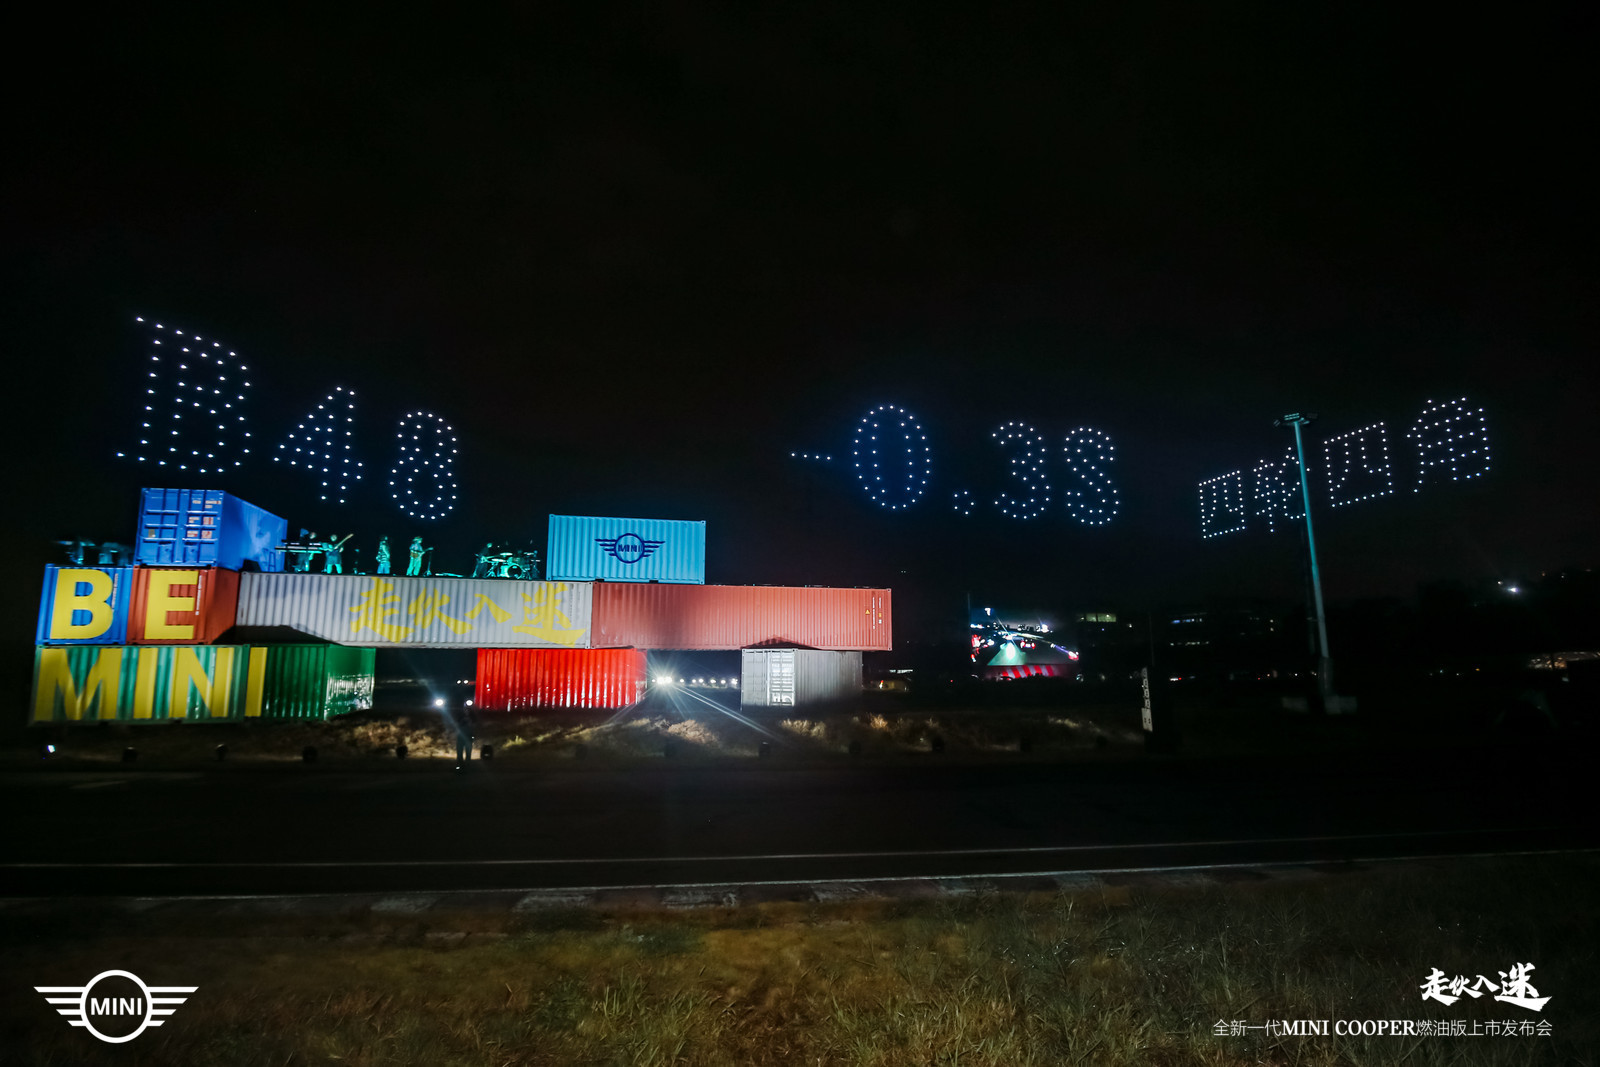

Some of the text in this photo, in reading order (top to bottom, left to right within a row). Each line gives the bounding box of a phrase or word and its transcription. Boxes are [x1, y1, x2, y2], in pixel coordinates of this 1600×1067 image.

[116, 315, 460, 520] B48
[1198, 397, 1490, 538] 四轮四角
[617, 544, 643, 553] MINI
[49, 568, 199, 640] BE
[349, 576, 587, 648] 走伙入迷
[34, 646, 268, 721] MINI
